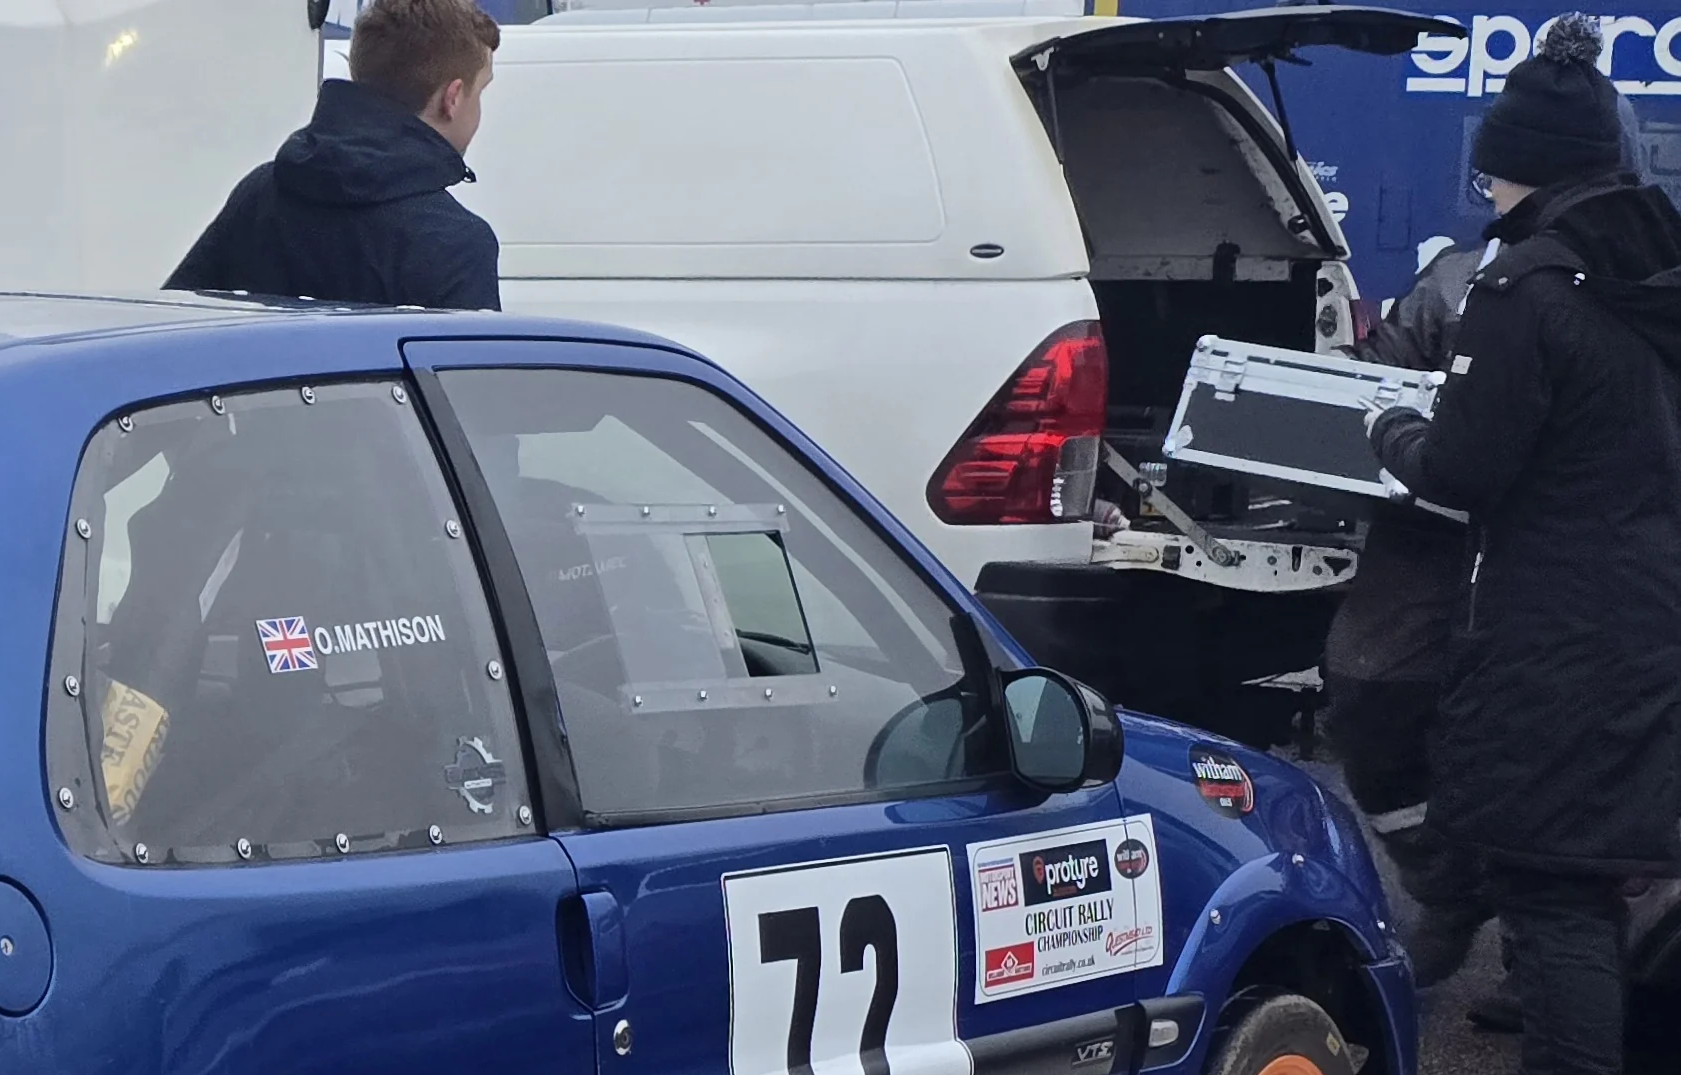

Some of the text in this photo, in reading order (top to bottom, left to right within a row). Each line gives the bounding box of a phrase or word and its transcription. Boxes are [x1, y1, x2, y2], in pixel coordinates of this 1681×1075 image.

[314, 615, 445, 654] O.MATHISON
[1192, 756, 1242, 780] witham
[1045, 854, 1099, 895] protyre
[982, 878, 1017, 909] NEWS
[1025, 898, 1114, 936] CIRCUIT RALLY
[1037, 925, 1104, 952] CHAMPIONSHIP
[1042, 955, 1096, 976] circuitrally.co.uk
